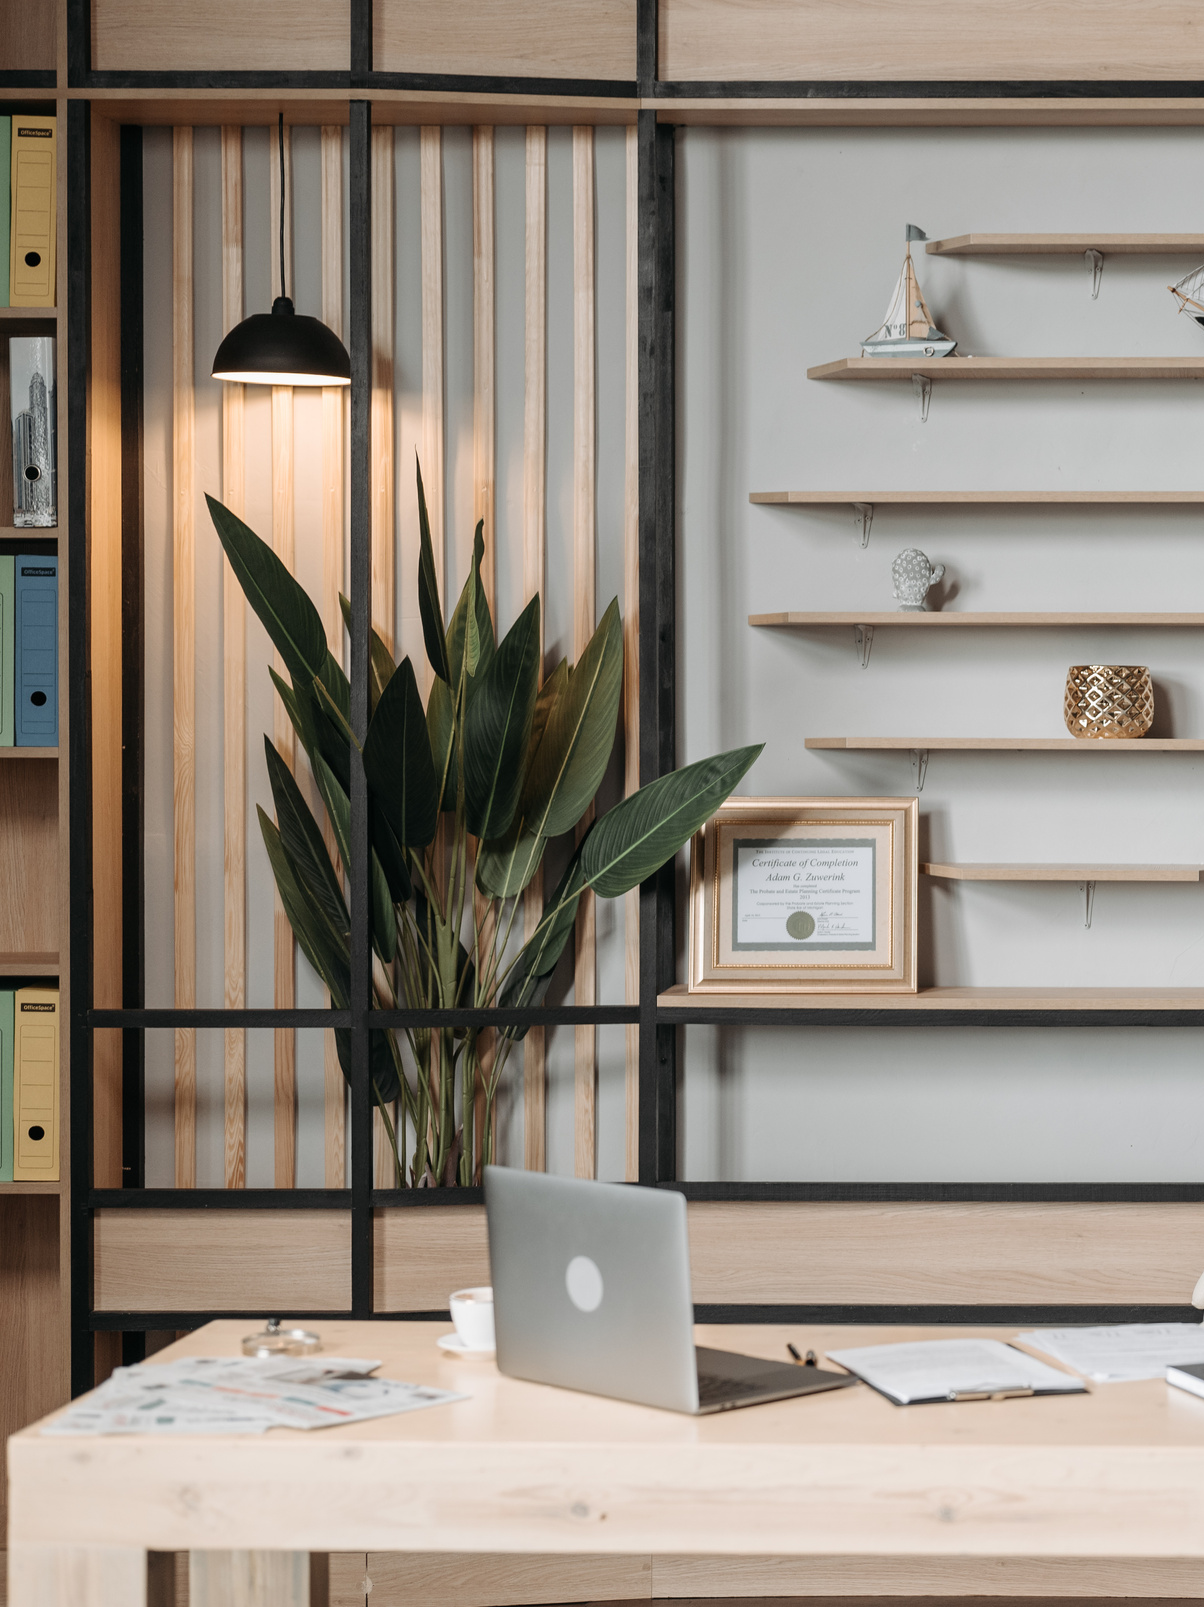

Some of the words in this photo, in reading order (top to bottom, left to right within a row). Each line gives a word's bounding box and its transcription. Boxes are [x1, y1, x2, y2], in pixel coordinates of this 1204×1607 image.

[752, 858, 797, 868] Certificate
[798, 858, 808, 868] of
[810, 858, 858, 868] Completion
[766, 872, 790, 882] Adam
[793, 872, 802, 882] G.
